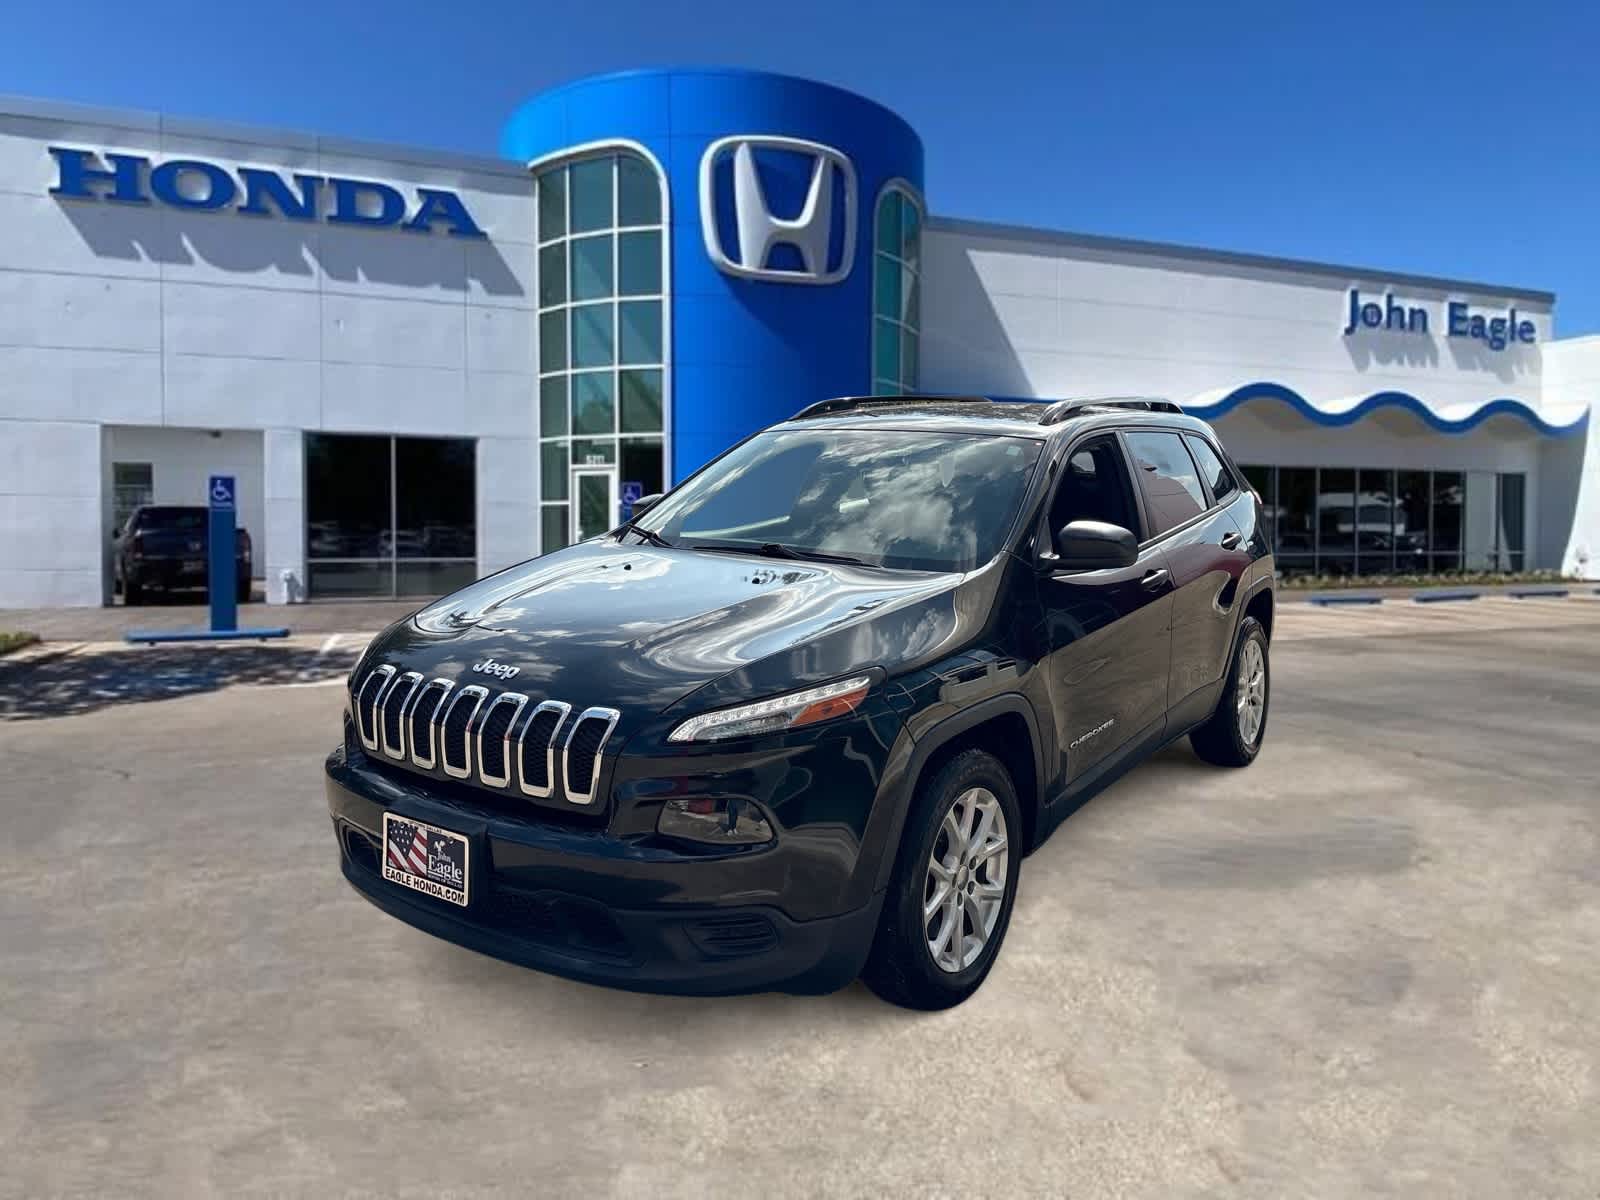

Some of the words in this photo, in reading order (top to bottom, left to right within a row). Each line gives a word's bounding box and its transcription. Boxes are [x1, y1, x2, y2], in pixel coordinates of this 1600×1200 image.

[48, 146, 488, 238] HONDA
[1344, 289, 1429, 336] John
[1448, 301, 1536, 351] Eagle
[472, 658, 521, 680] Jeep
[1070, 718, 1115, 749] CHEROKEE
[428, 853, 463, 880] Eagle
[437, 850, 452, 863] John
[385, 868, 412, 885] EAGLE
[413, 877, 465, 905] HONDA.COM
